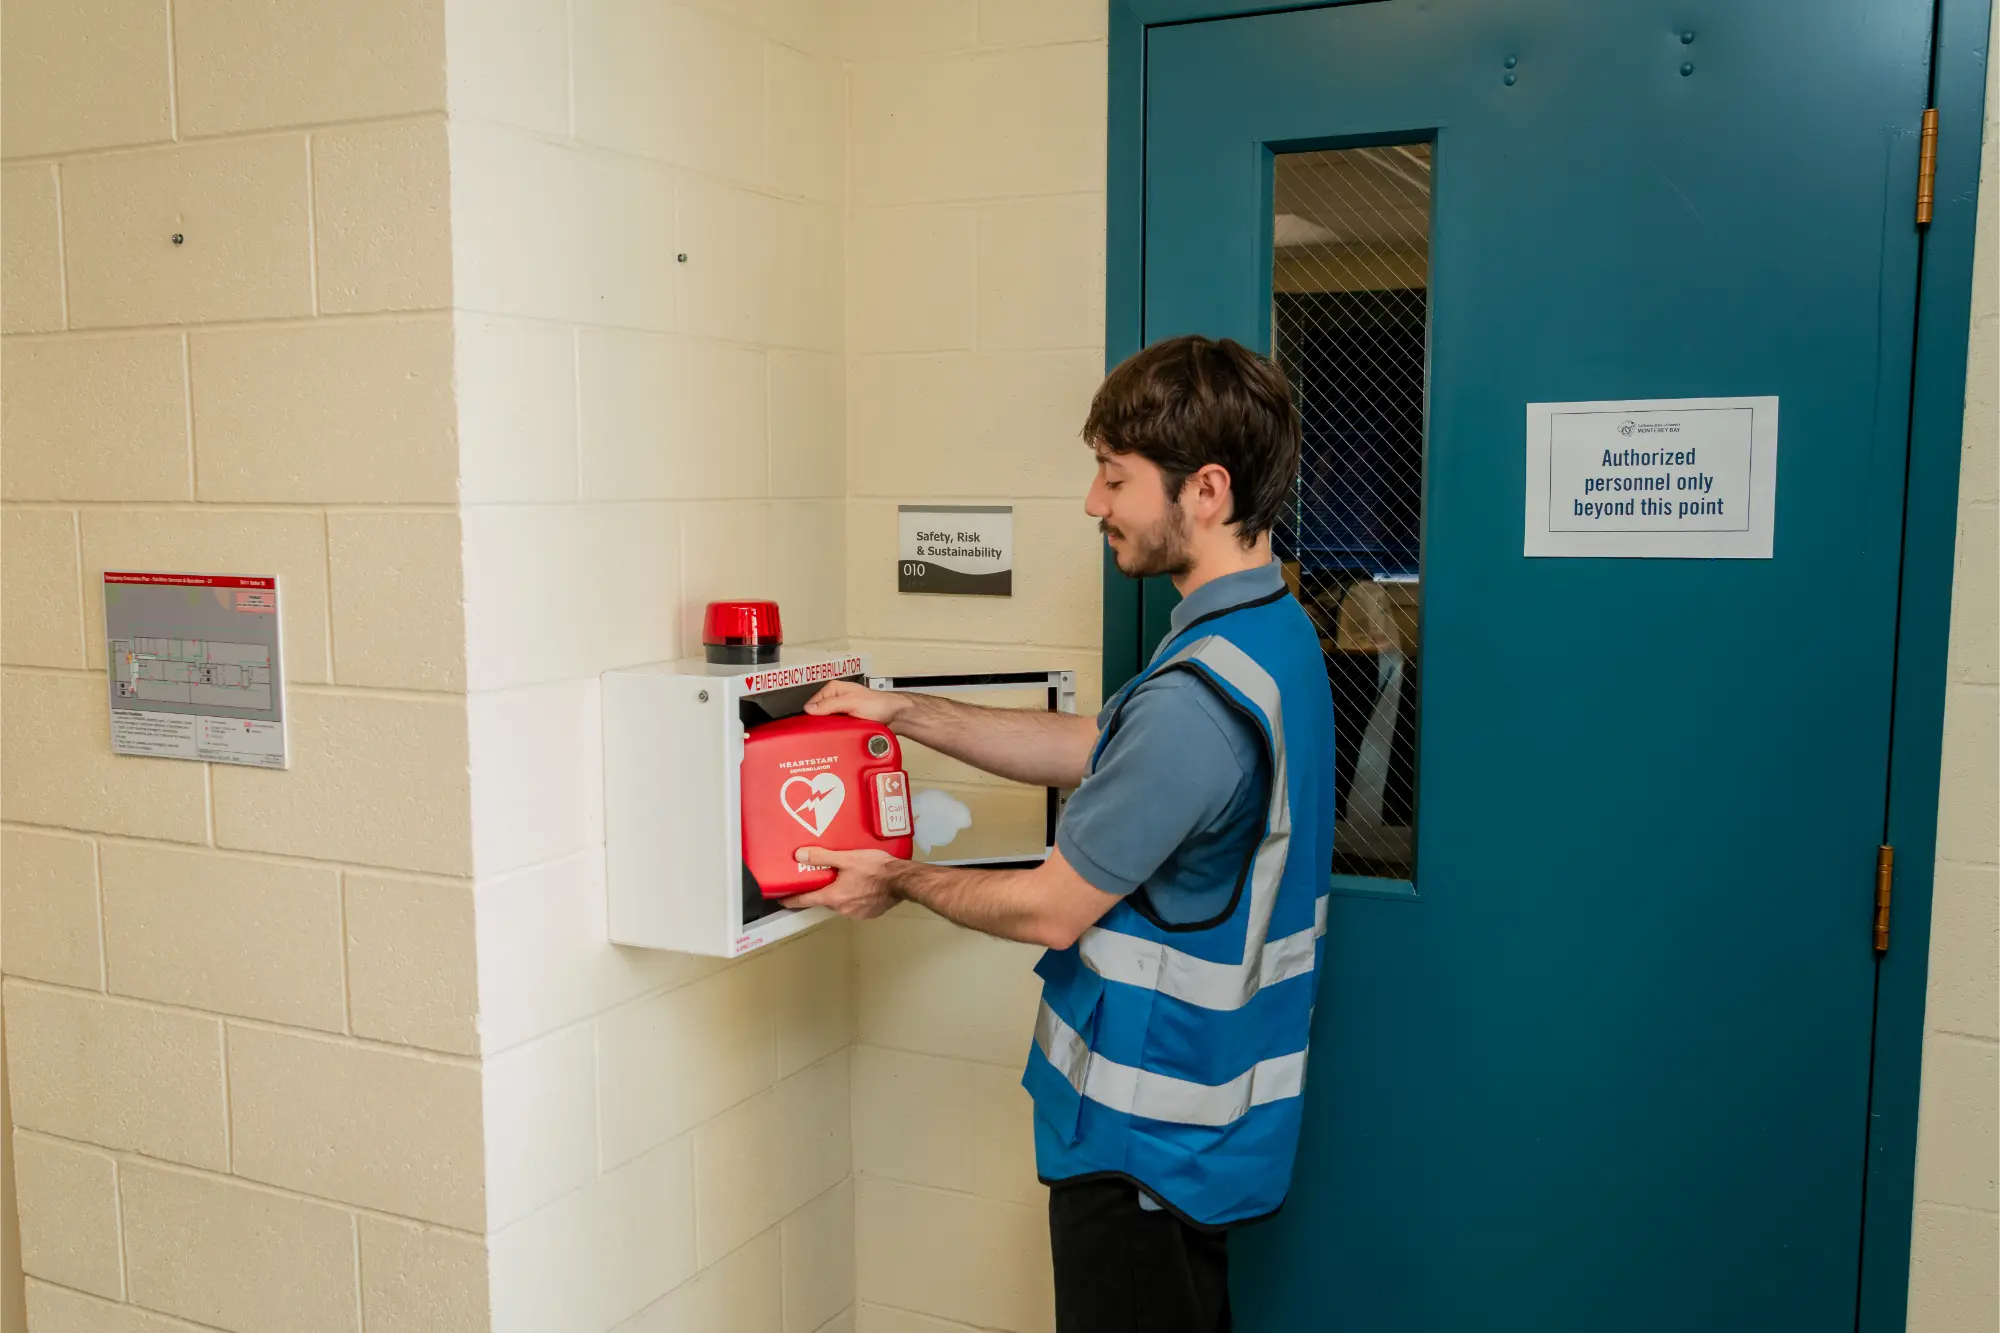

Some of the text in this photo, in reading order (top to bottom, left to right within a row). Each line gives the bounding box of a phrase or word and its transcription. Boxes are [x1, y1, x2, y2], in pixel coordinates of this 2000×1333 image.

[1602, 448, 1696, 466] Authorized
[1585, 472, 1714, 495] personnel only
[1574, 497, 1724, 519] beyond this point
[916, 531, 981, 544] Safety, Risk
[917, 546, 1002, 560] & Sustainability
[903, 563, 925, 577] 010
[755, 657, 861, 691] EMERGENCY DEFIBRILLATOR
[779, 756, 839, 769] HEARTSTART
[790, 764, 831, 774] DEFIBRILLATOR
